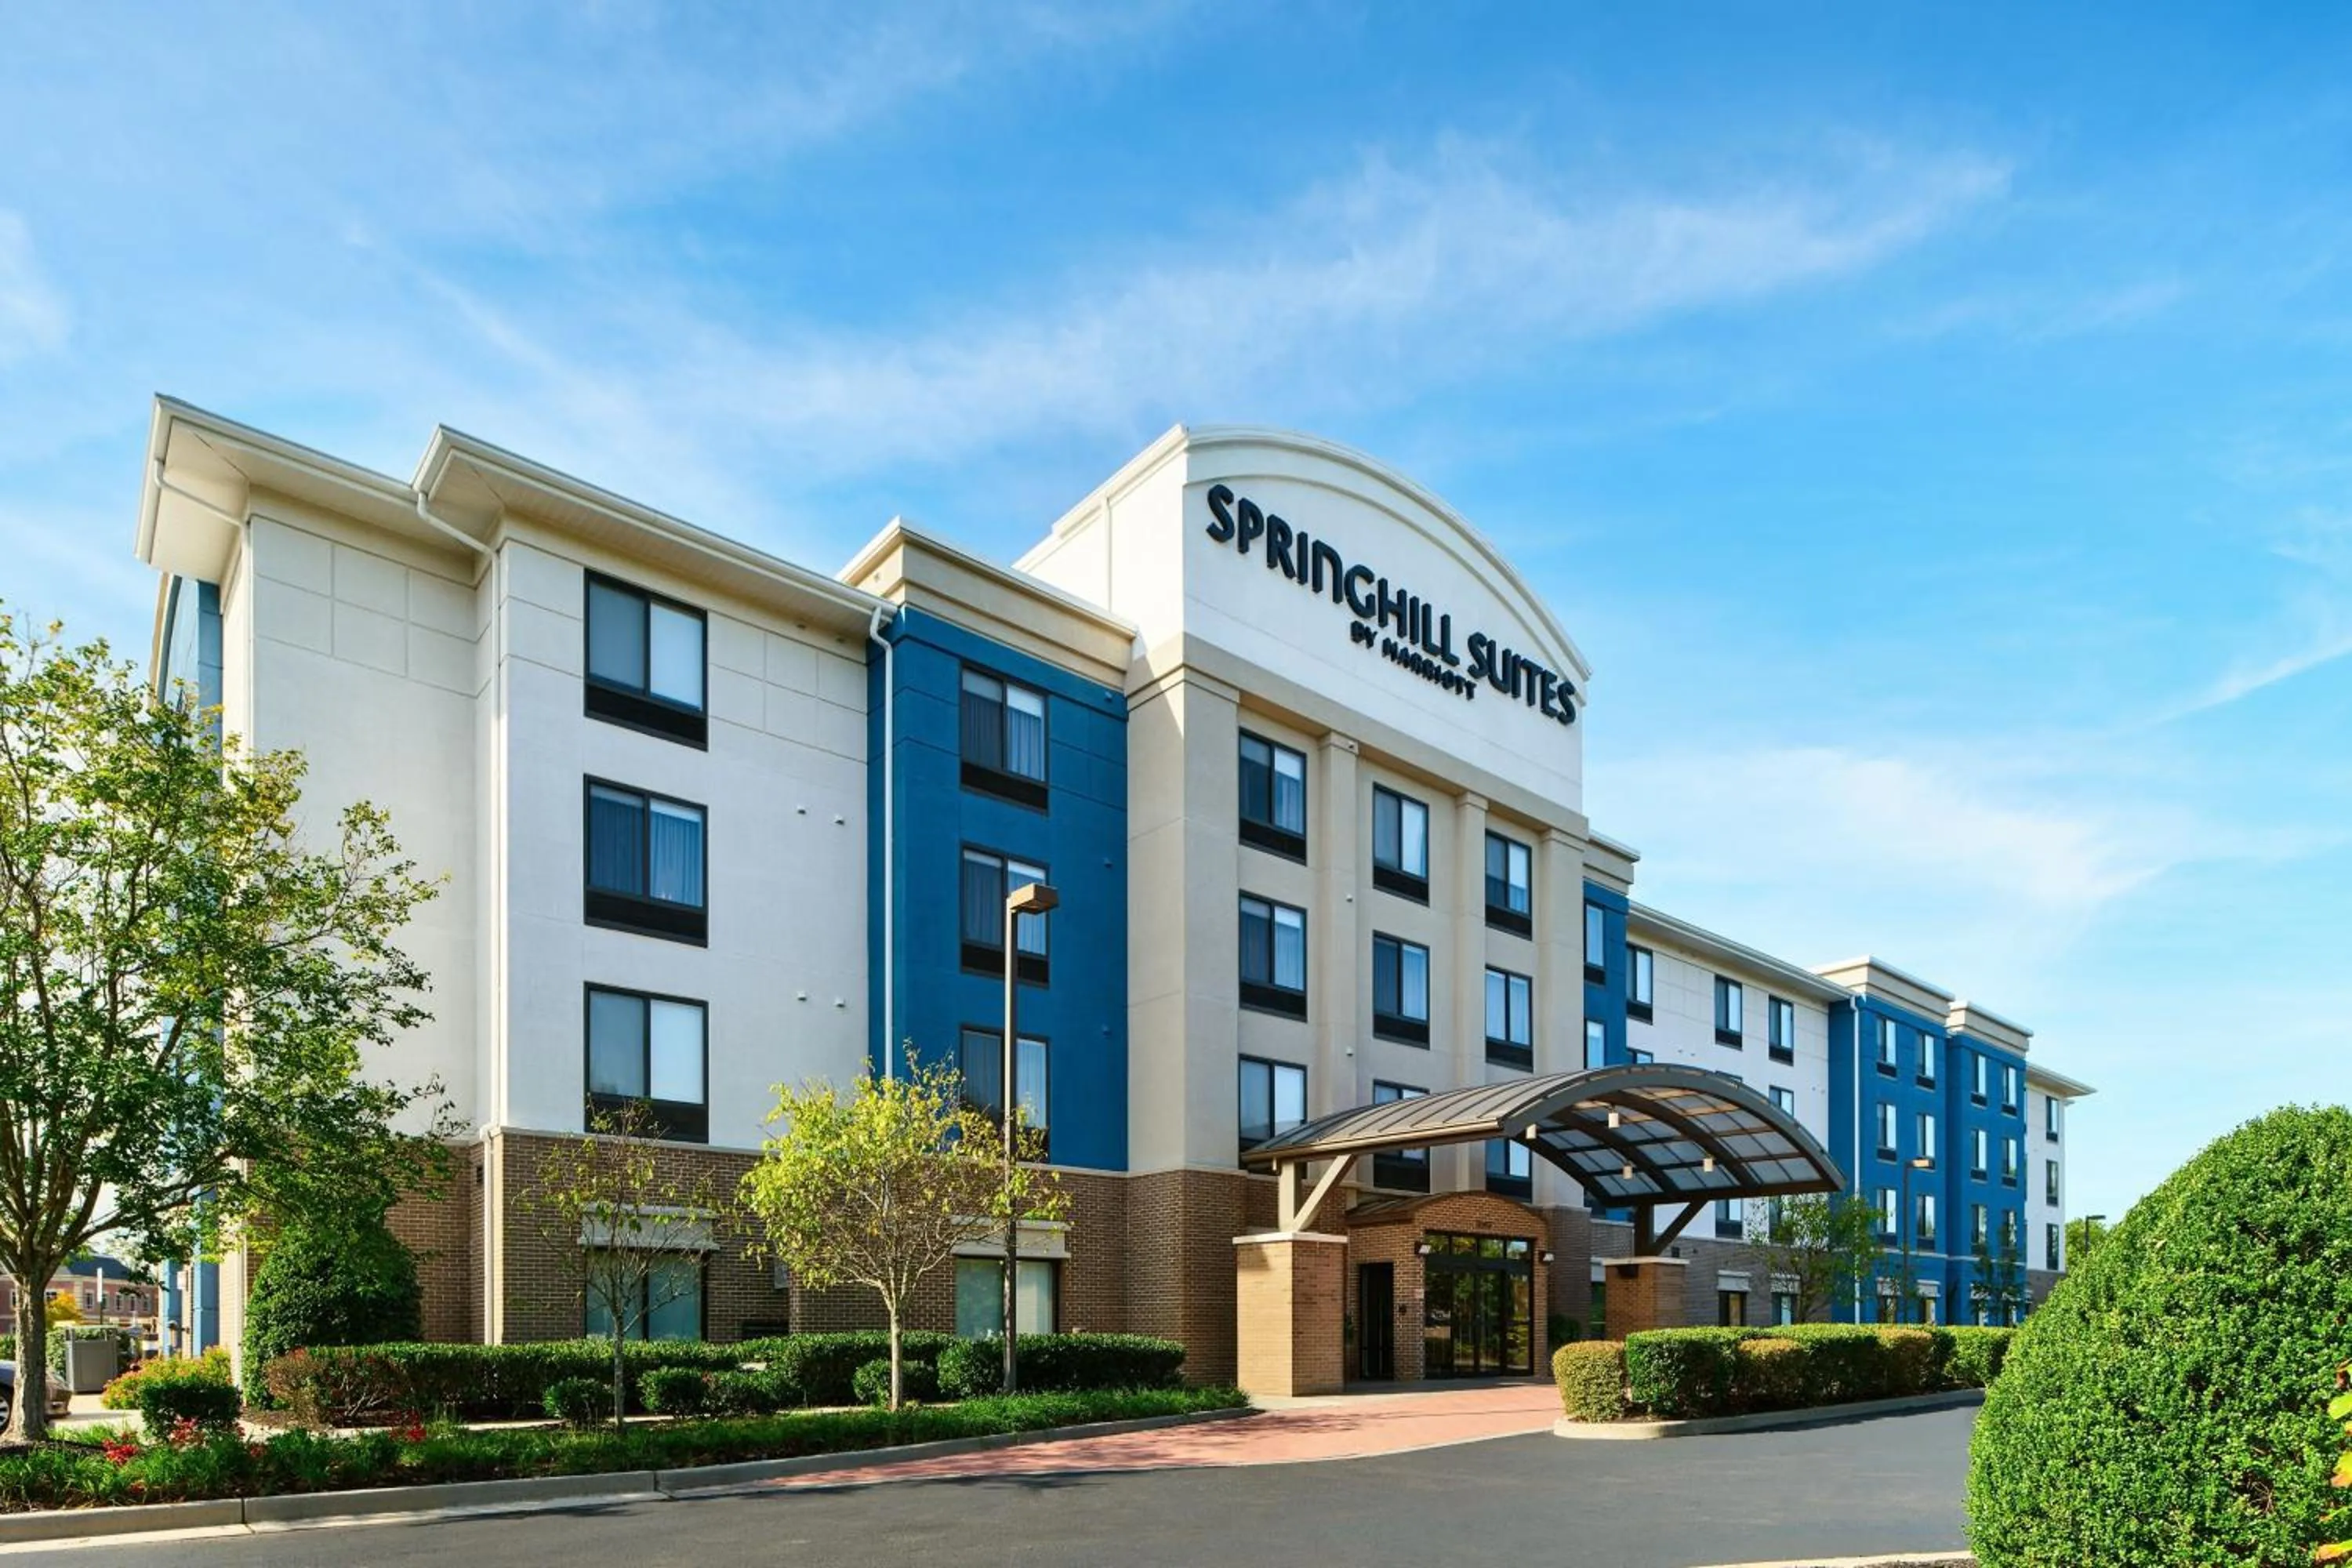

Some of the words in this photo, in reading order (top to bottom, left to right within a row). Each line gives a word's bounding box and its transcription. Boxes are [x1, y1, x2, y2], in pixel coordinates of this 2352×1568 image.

[1206, 484, 1460, 666] SPRINGHILL
[1467, 631, 1577, 726] SUITES
[1350, 620, 1378, 650] BY
[1382, 637, 1477, 701] MARRIOTT
